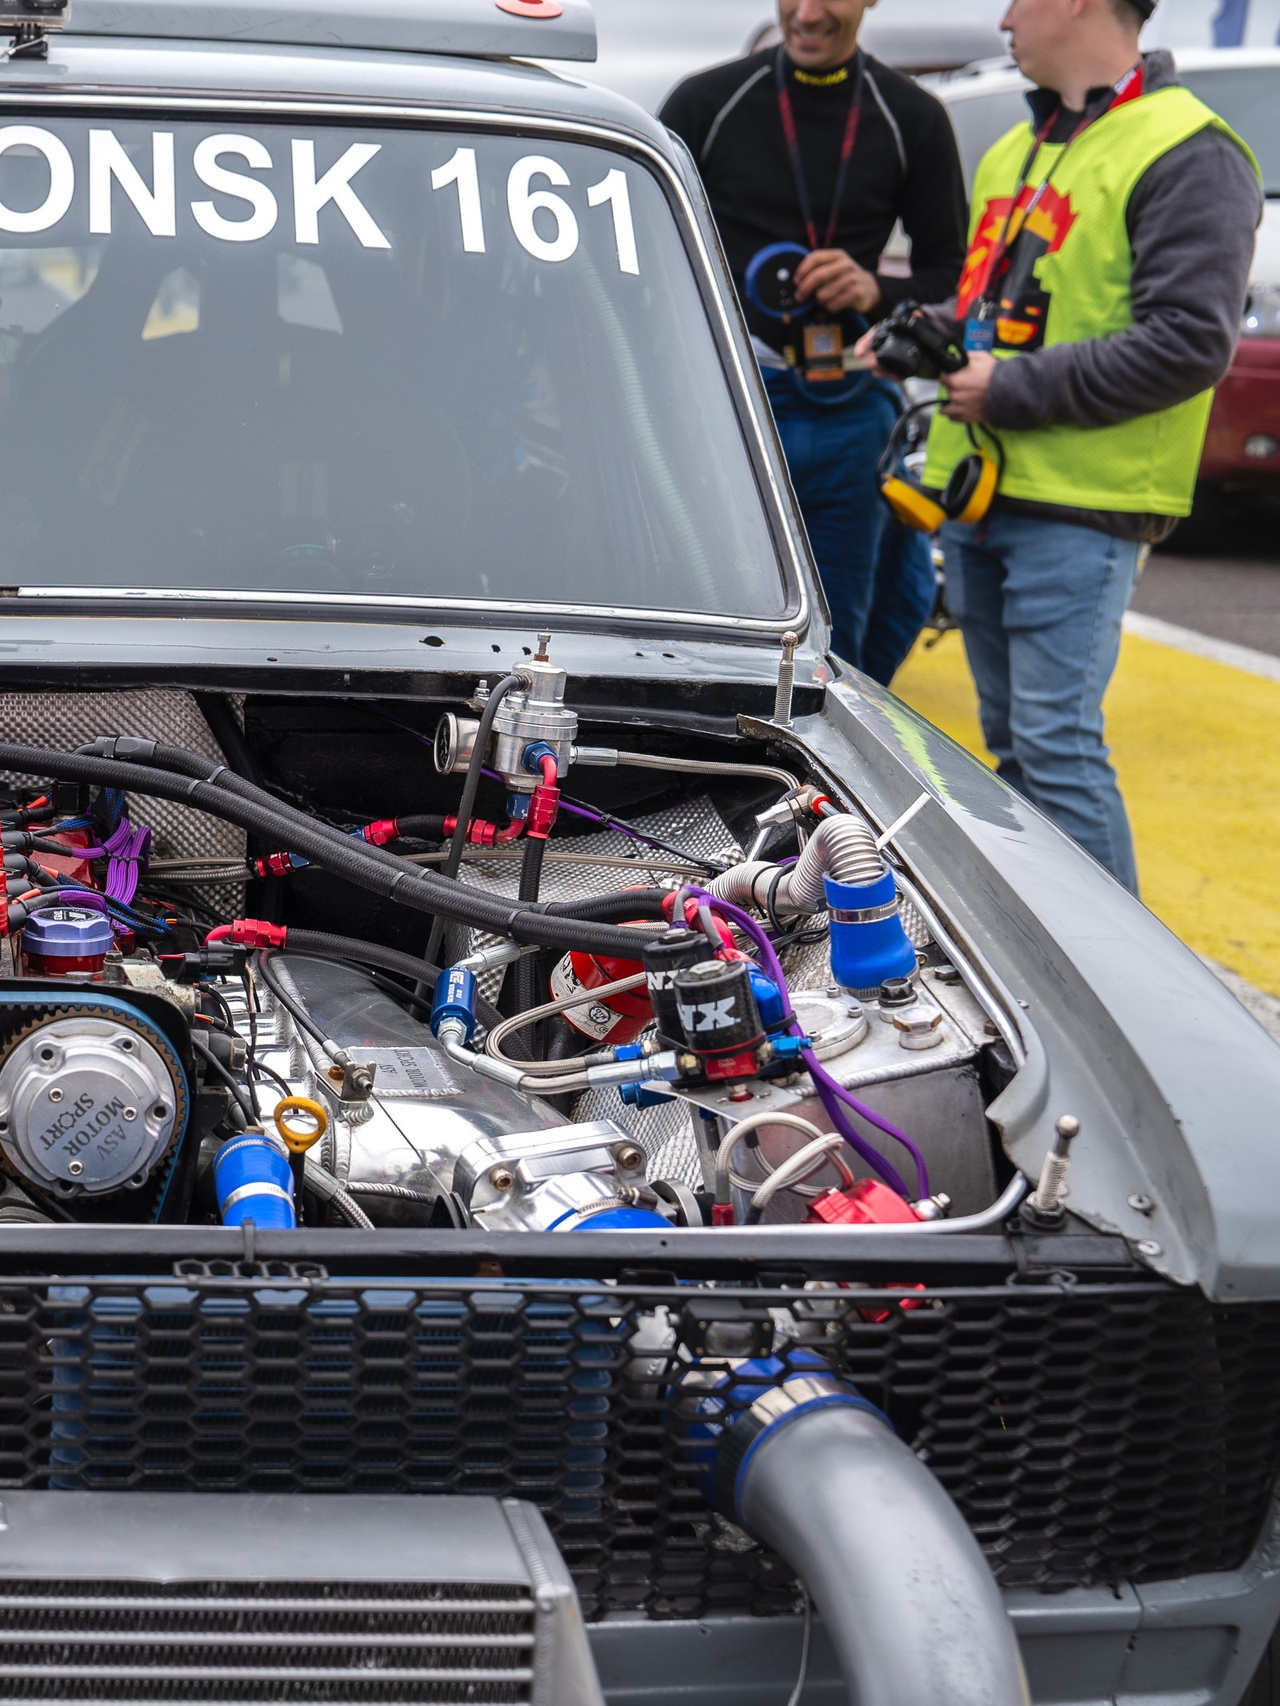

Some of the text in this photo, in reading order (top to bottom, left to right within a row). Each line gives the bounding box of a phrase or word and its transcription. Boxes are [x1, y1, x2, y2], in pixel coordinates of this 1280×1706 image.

[430, 146, 640, 276] 161
[38, 1092, 95, 1152] SPORT
[61, 1095, 127, 1157] MOTOR
[96, 1123, 127, 1160] ASV
